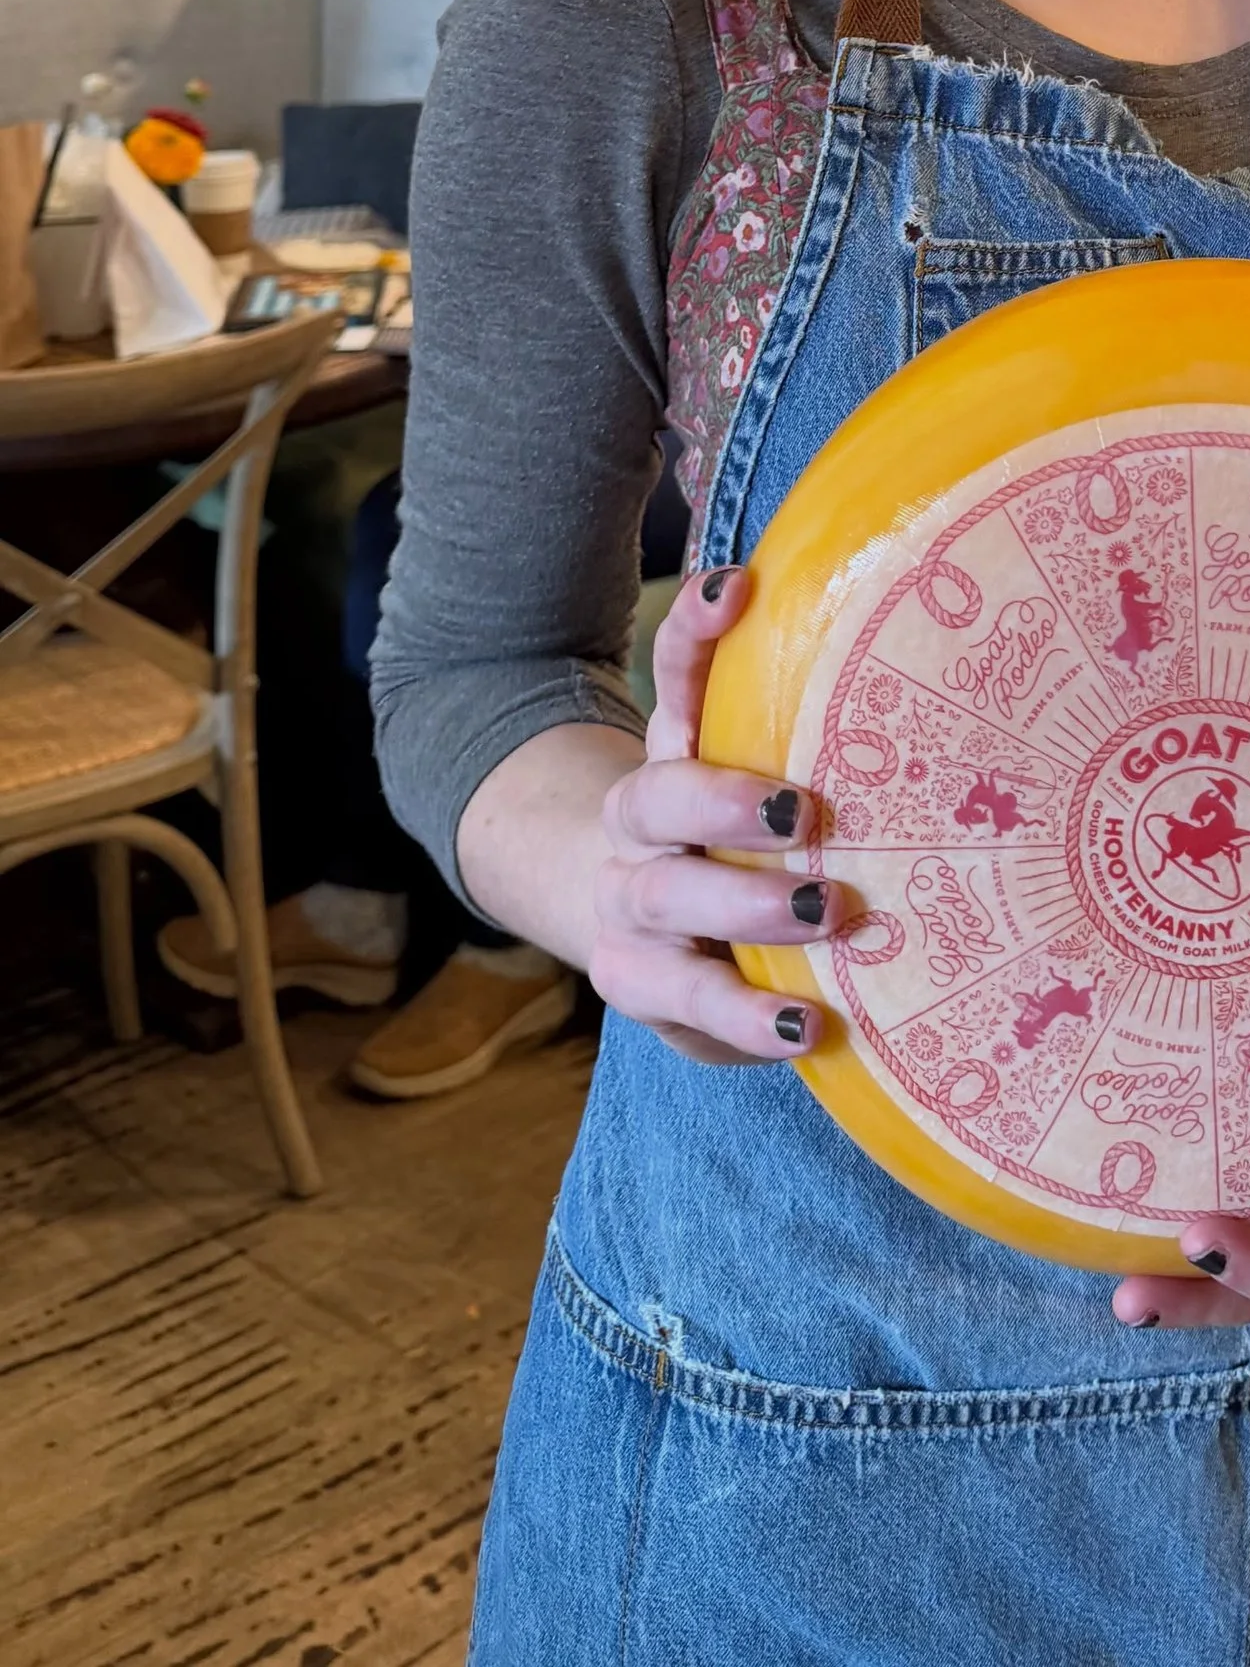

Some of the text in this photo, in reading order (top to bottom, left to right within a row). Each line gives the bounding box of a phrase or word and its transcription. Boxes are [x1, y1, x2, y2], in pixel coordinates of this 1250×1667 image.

[1210, 621, 1243, 635] FARM
[942, 620, 1012, 710] Goat
[991, 618, 1058, 719] Rodeo
[1088, 800, 1104, 848] GOUDA
[1089, 852, 1114, 902] CHEESE
[1103, 818, 1234, 942] HOOTENANNY
[936, 865, 1006, 954] Rodeo
[1110, 903, 1142, 934] MADE
[918, 904, 983, 987] Goat
[1142, 931, 1178, 953] FROM
[1182, 946, 1217, 957] GOAT
[1092, 1058, 1201, 1101] Rodeo
[1122, 1092, 1209, 1144] Goat
